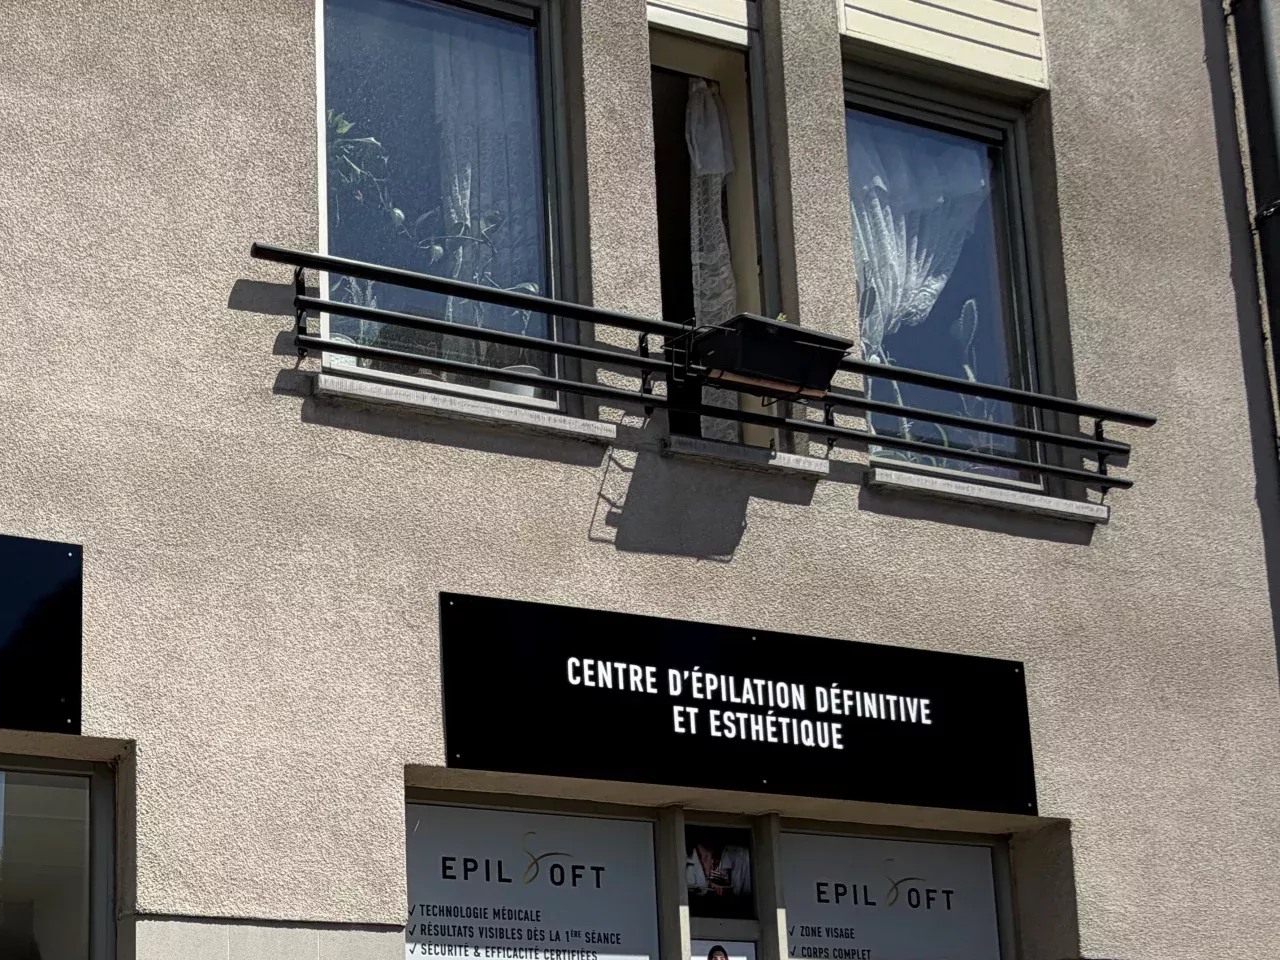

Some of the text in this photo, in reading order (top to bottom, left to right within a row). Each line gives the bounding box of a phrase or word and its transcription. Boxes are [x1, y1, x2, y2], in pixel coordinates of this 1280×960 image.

[566, 656, 933, 725] CENTRE D'ÉPILATION DÉFINITIVE
[672, 705, 844, 750] ET ESTHÉTIQUE
[419, 904, 541, 922] TECHNOLOGIE MÉDICALE
[420, 921, 474, 938] RÉSULTATS
[478, 926, 523, 941] VISIBLES
[527, 925, 545, 942] DÈS
[550, 930, 561, 942] LA
[585, 929, 622, 945] SÉANCE
[800, 926, 856, 939] ZONE VISAGE
[421, 941, 470, 957] SÉCURITÉ
[473, 945, 482, 957] &
[485, 945, 540, 960] EFFICACITÉ
[801, 946, 871, 960] CORPS COMPLET
